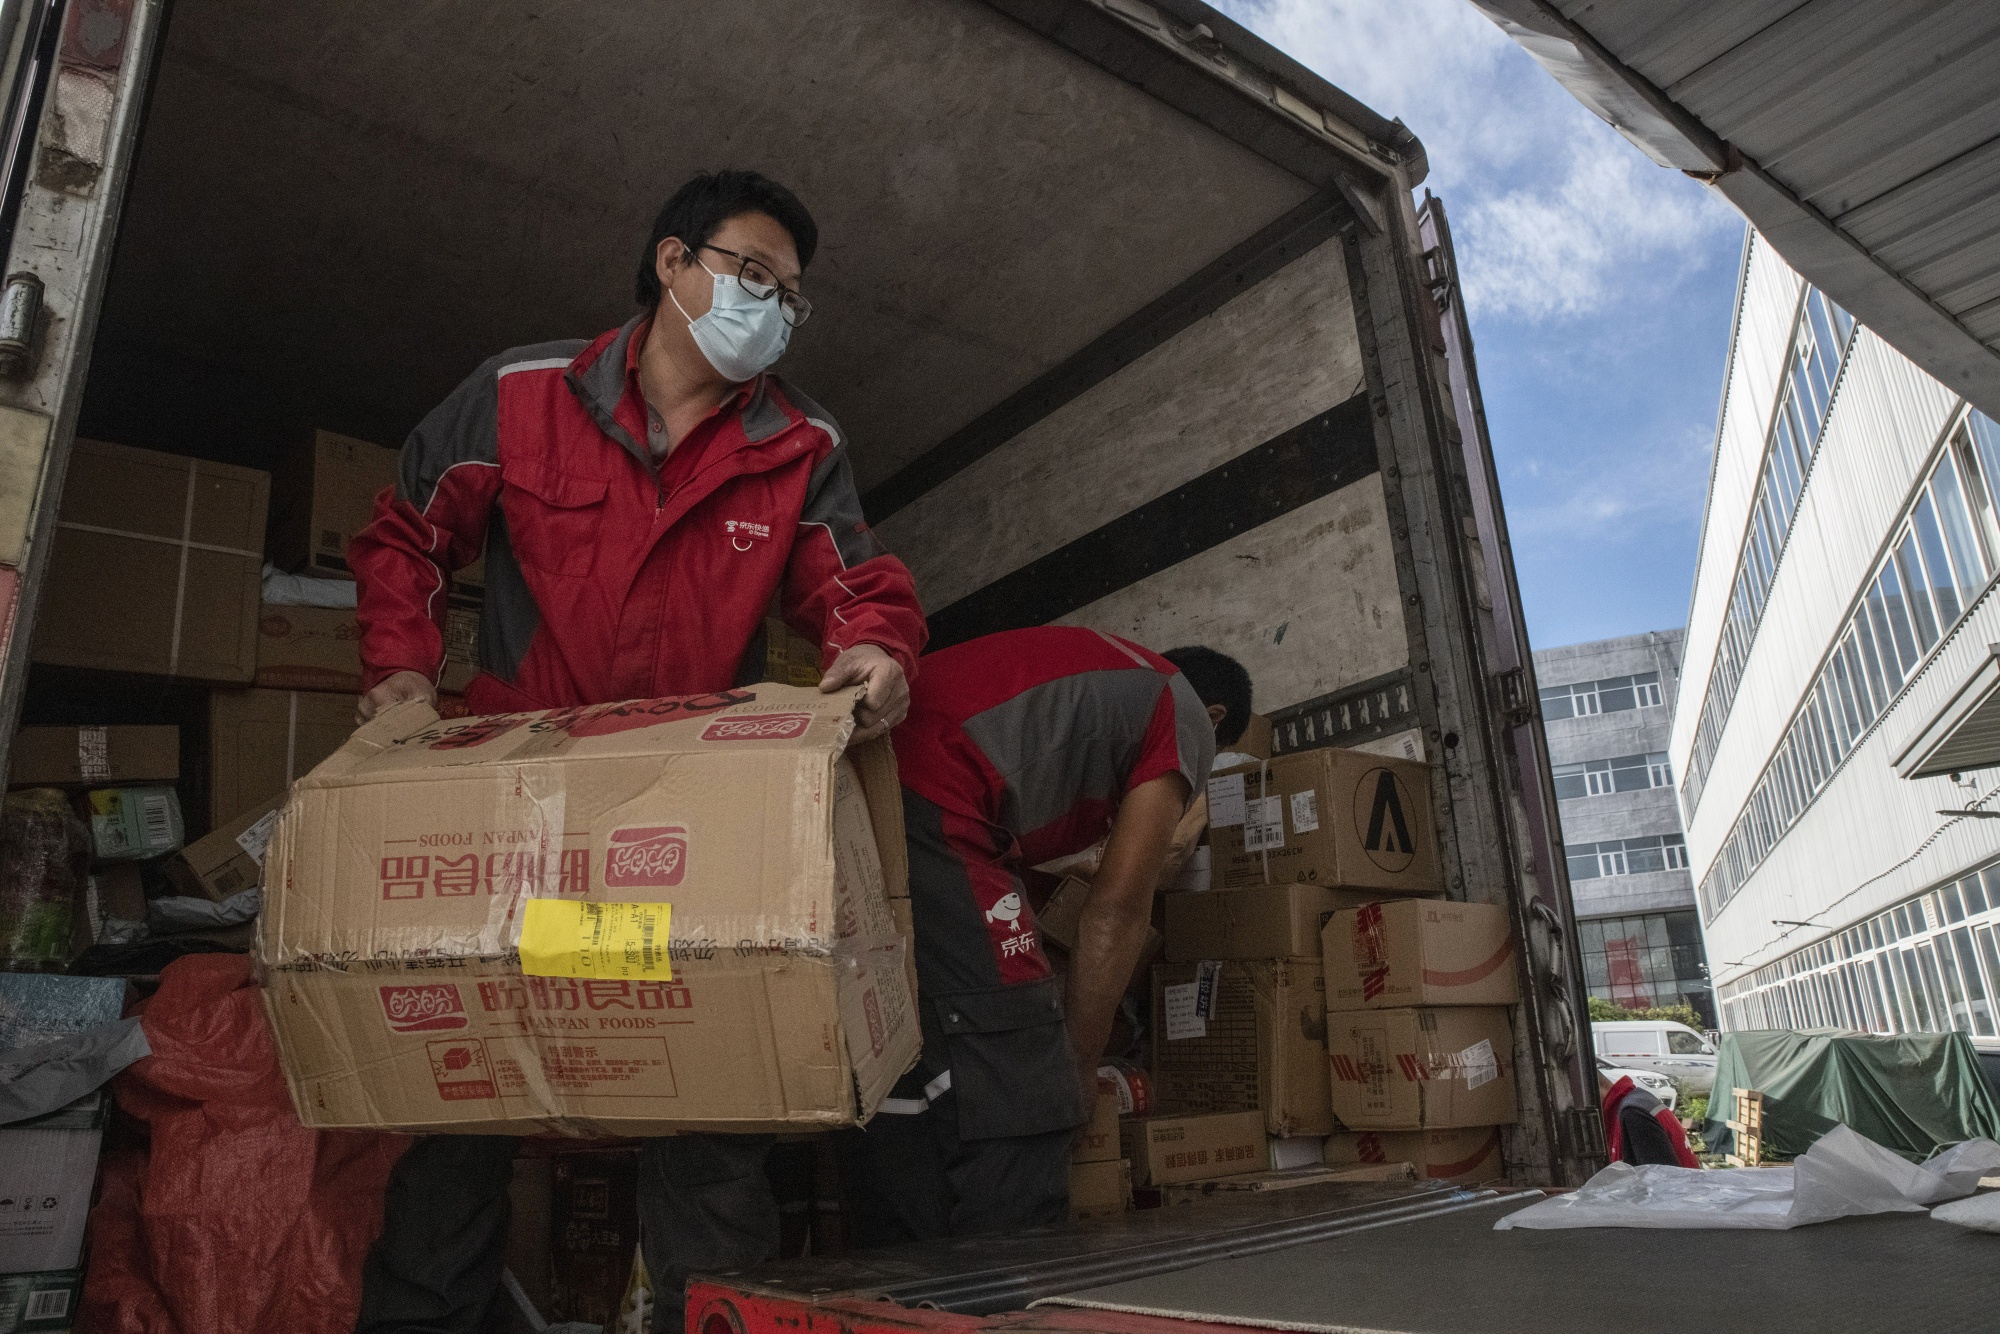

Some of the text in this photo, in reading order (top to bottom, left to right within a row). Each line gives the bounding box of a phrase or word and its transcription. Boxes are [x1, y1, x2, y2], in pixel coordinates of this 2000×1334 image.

[739, 521, 770, 533] 京东快递
[420, 829, 541, 847] ANPAN FOODS
[380, 849, 590, 900] 盼盼食品
[630, 903, 640, 923] A-A1
[1001, 931, 1035, 958] 京东
[477, 974, 693, 1011] 盼盼食品
[599, 1017, 656, 1030] FOODS
[547, 1045, 599, 1058] 特别警示
[1164, 1144, 1255, 1169] 品质商家 值得信赖
